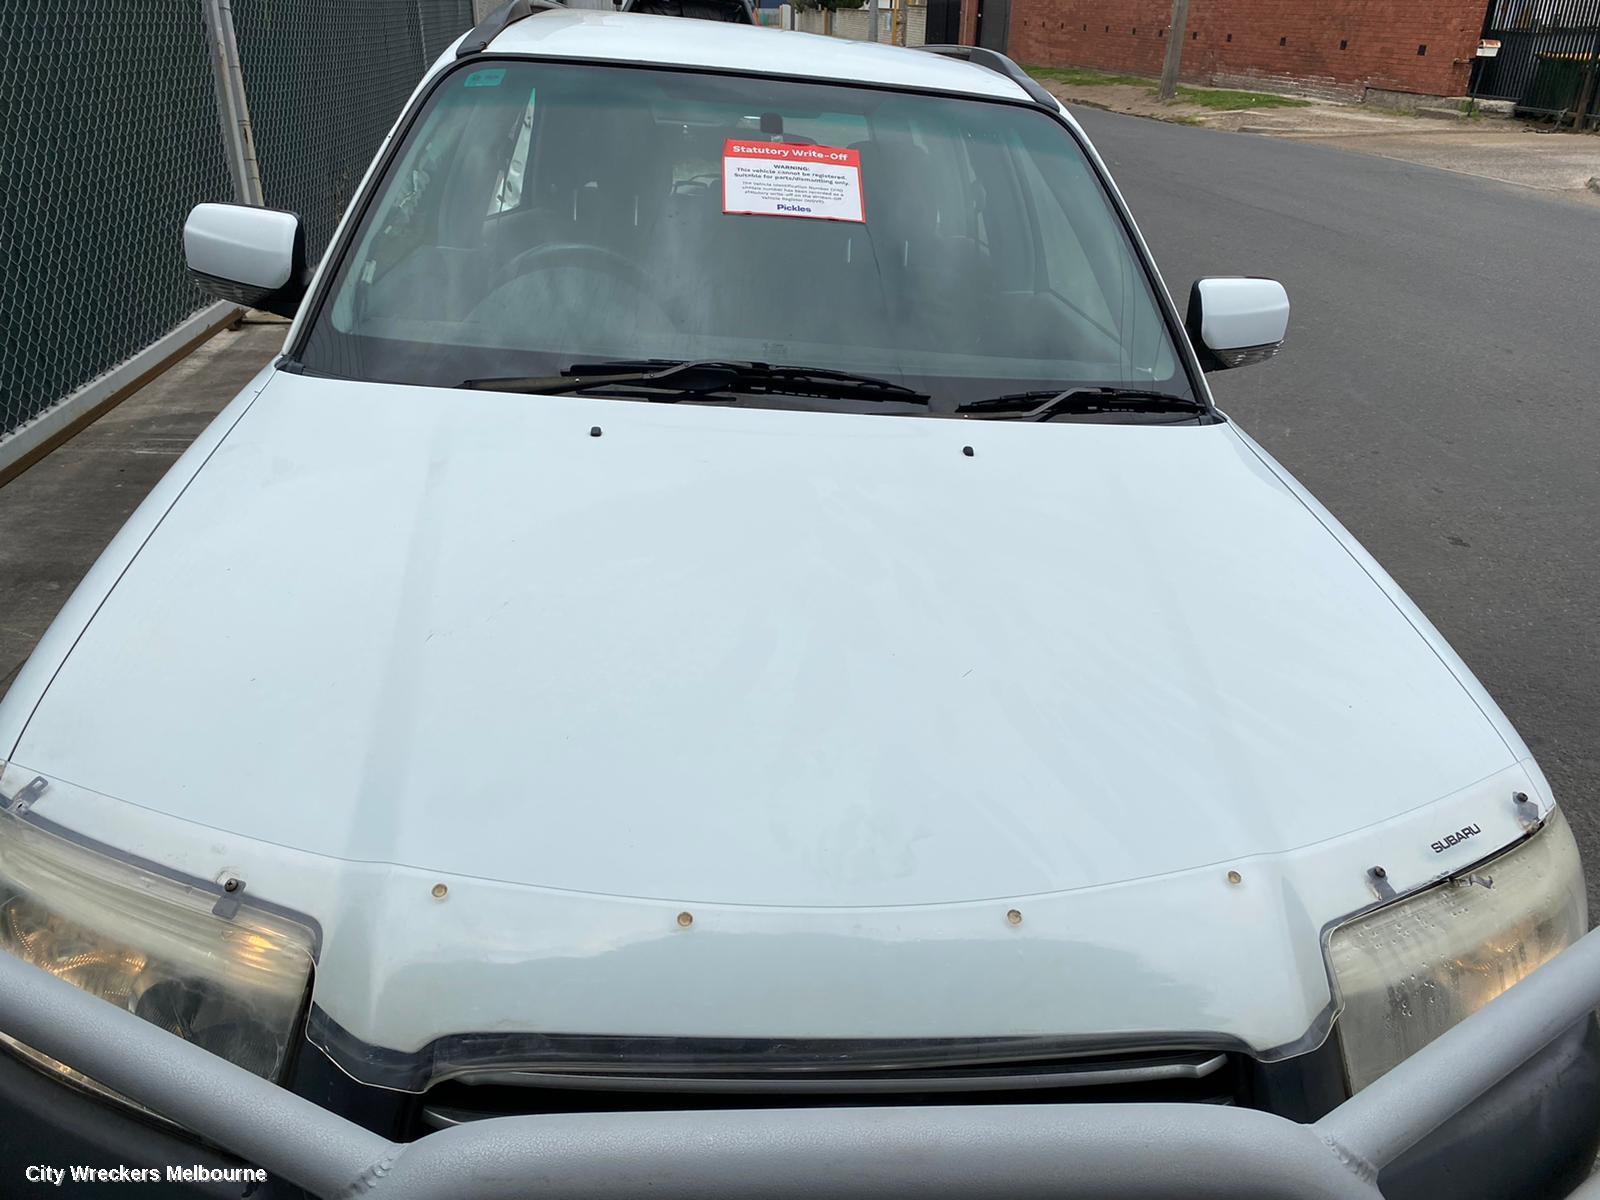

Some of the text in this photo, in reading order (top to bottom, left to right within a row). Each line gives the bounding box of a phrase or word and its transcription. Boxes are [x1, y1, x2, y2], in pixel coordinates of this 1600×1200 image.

[733, 145, 848, 160] Statutory Write-Off
[812, 172, 847, 180] registered.
[777, 203, 811, 212] Pickles
[1431, 823, 1481, 853] SUBARU
